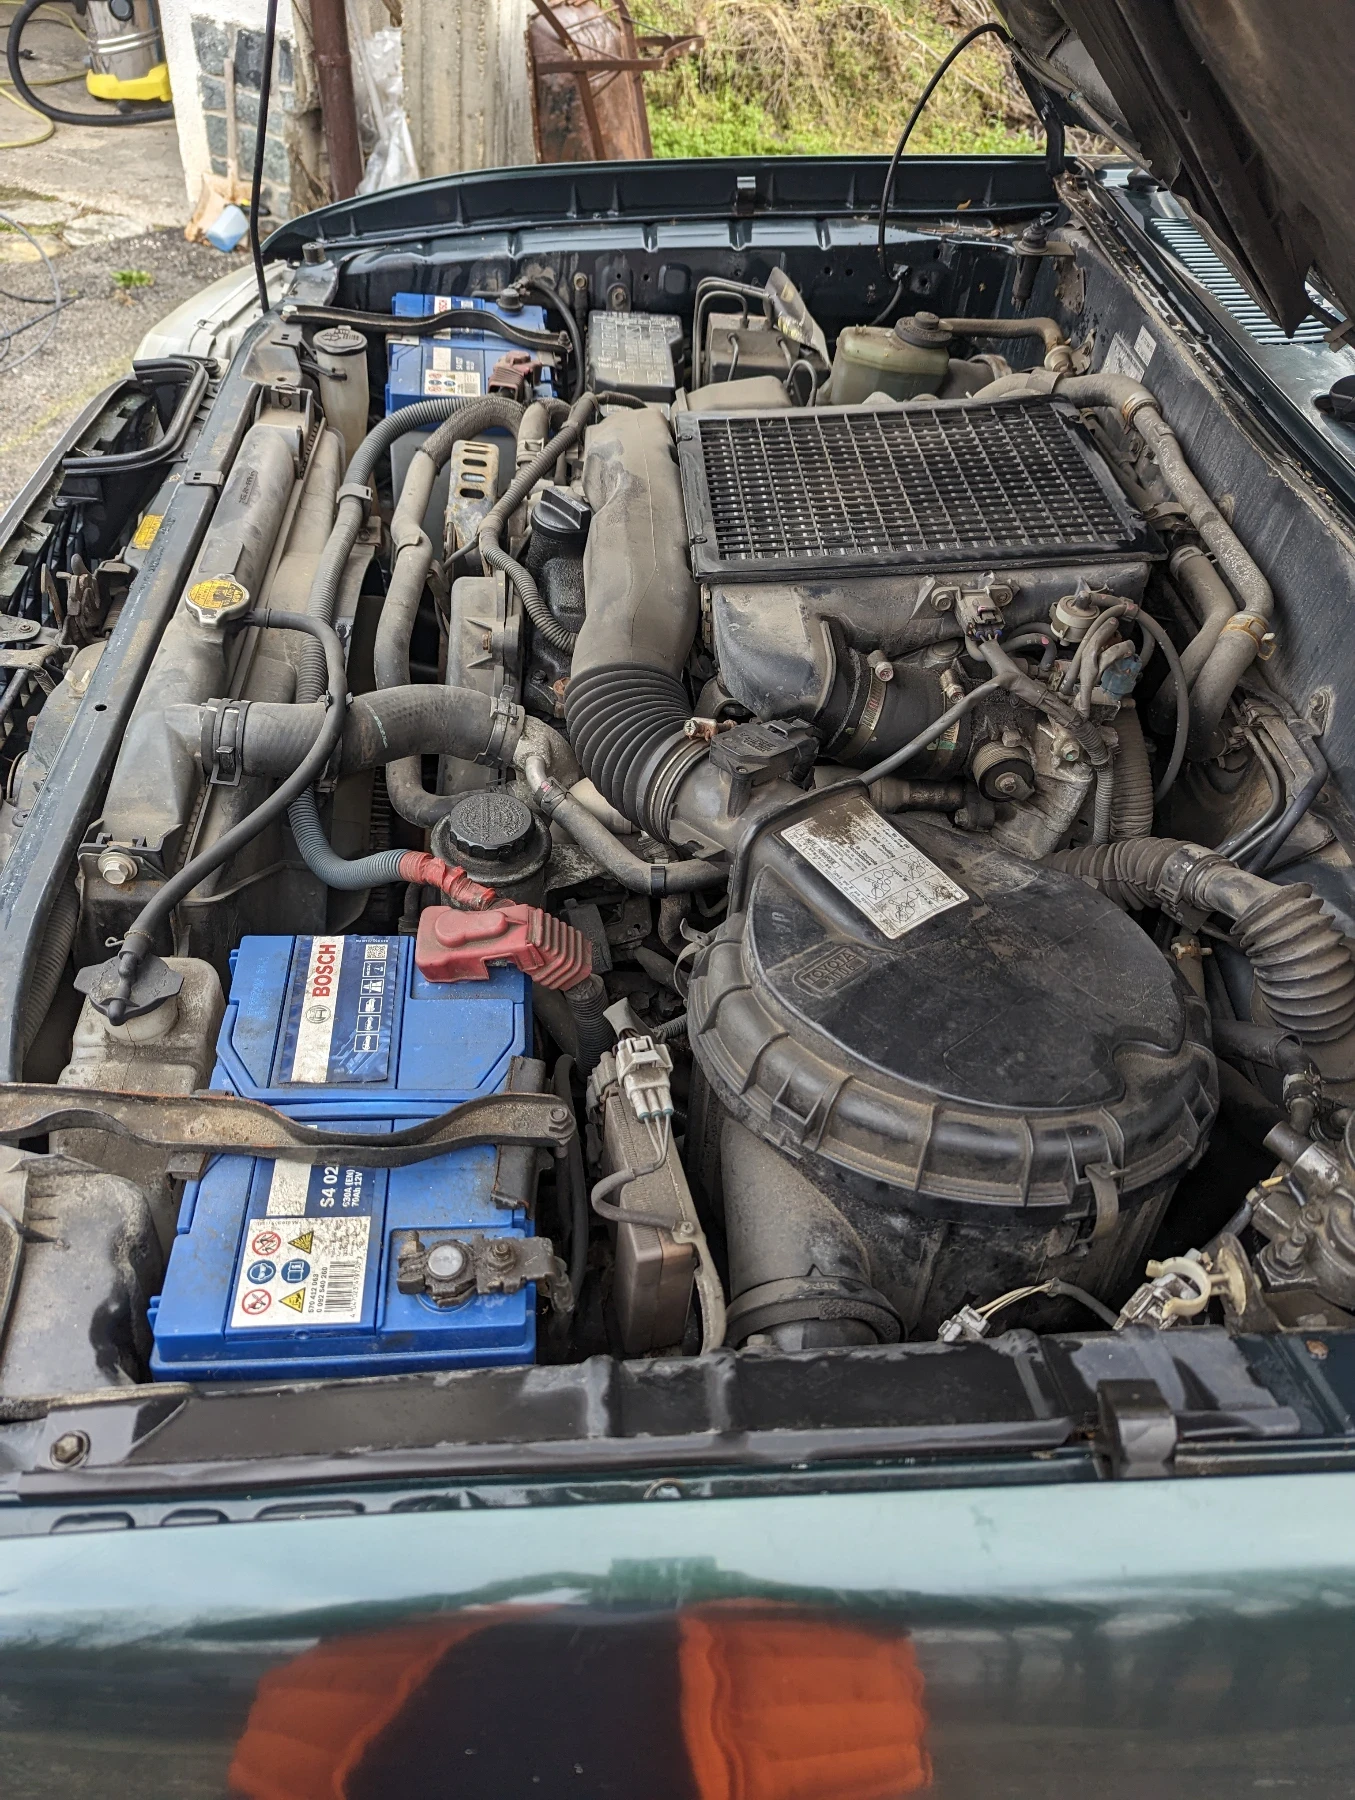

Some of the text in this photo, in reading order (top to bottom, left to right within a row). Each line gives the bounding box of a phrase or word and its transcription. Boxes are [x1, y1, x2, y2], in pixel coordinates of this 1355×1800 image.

[312, 944, 336, 997] BOSCH
[804, 952, 857, 984] TOYOTA
[346, 1170, 355, 1186] (EN)
[352, 1172, 363, 1207] 70Ah 12V
[320, 1188, 336, 1208] S4
